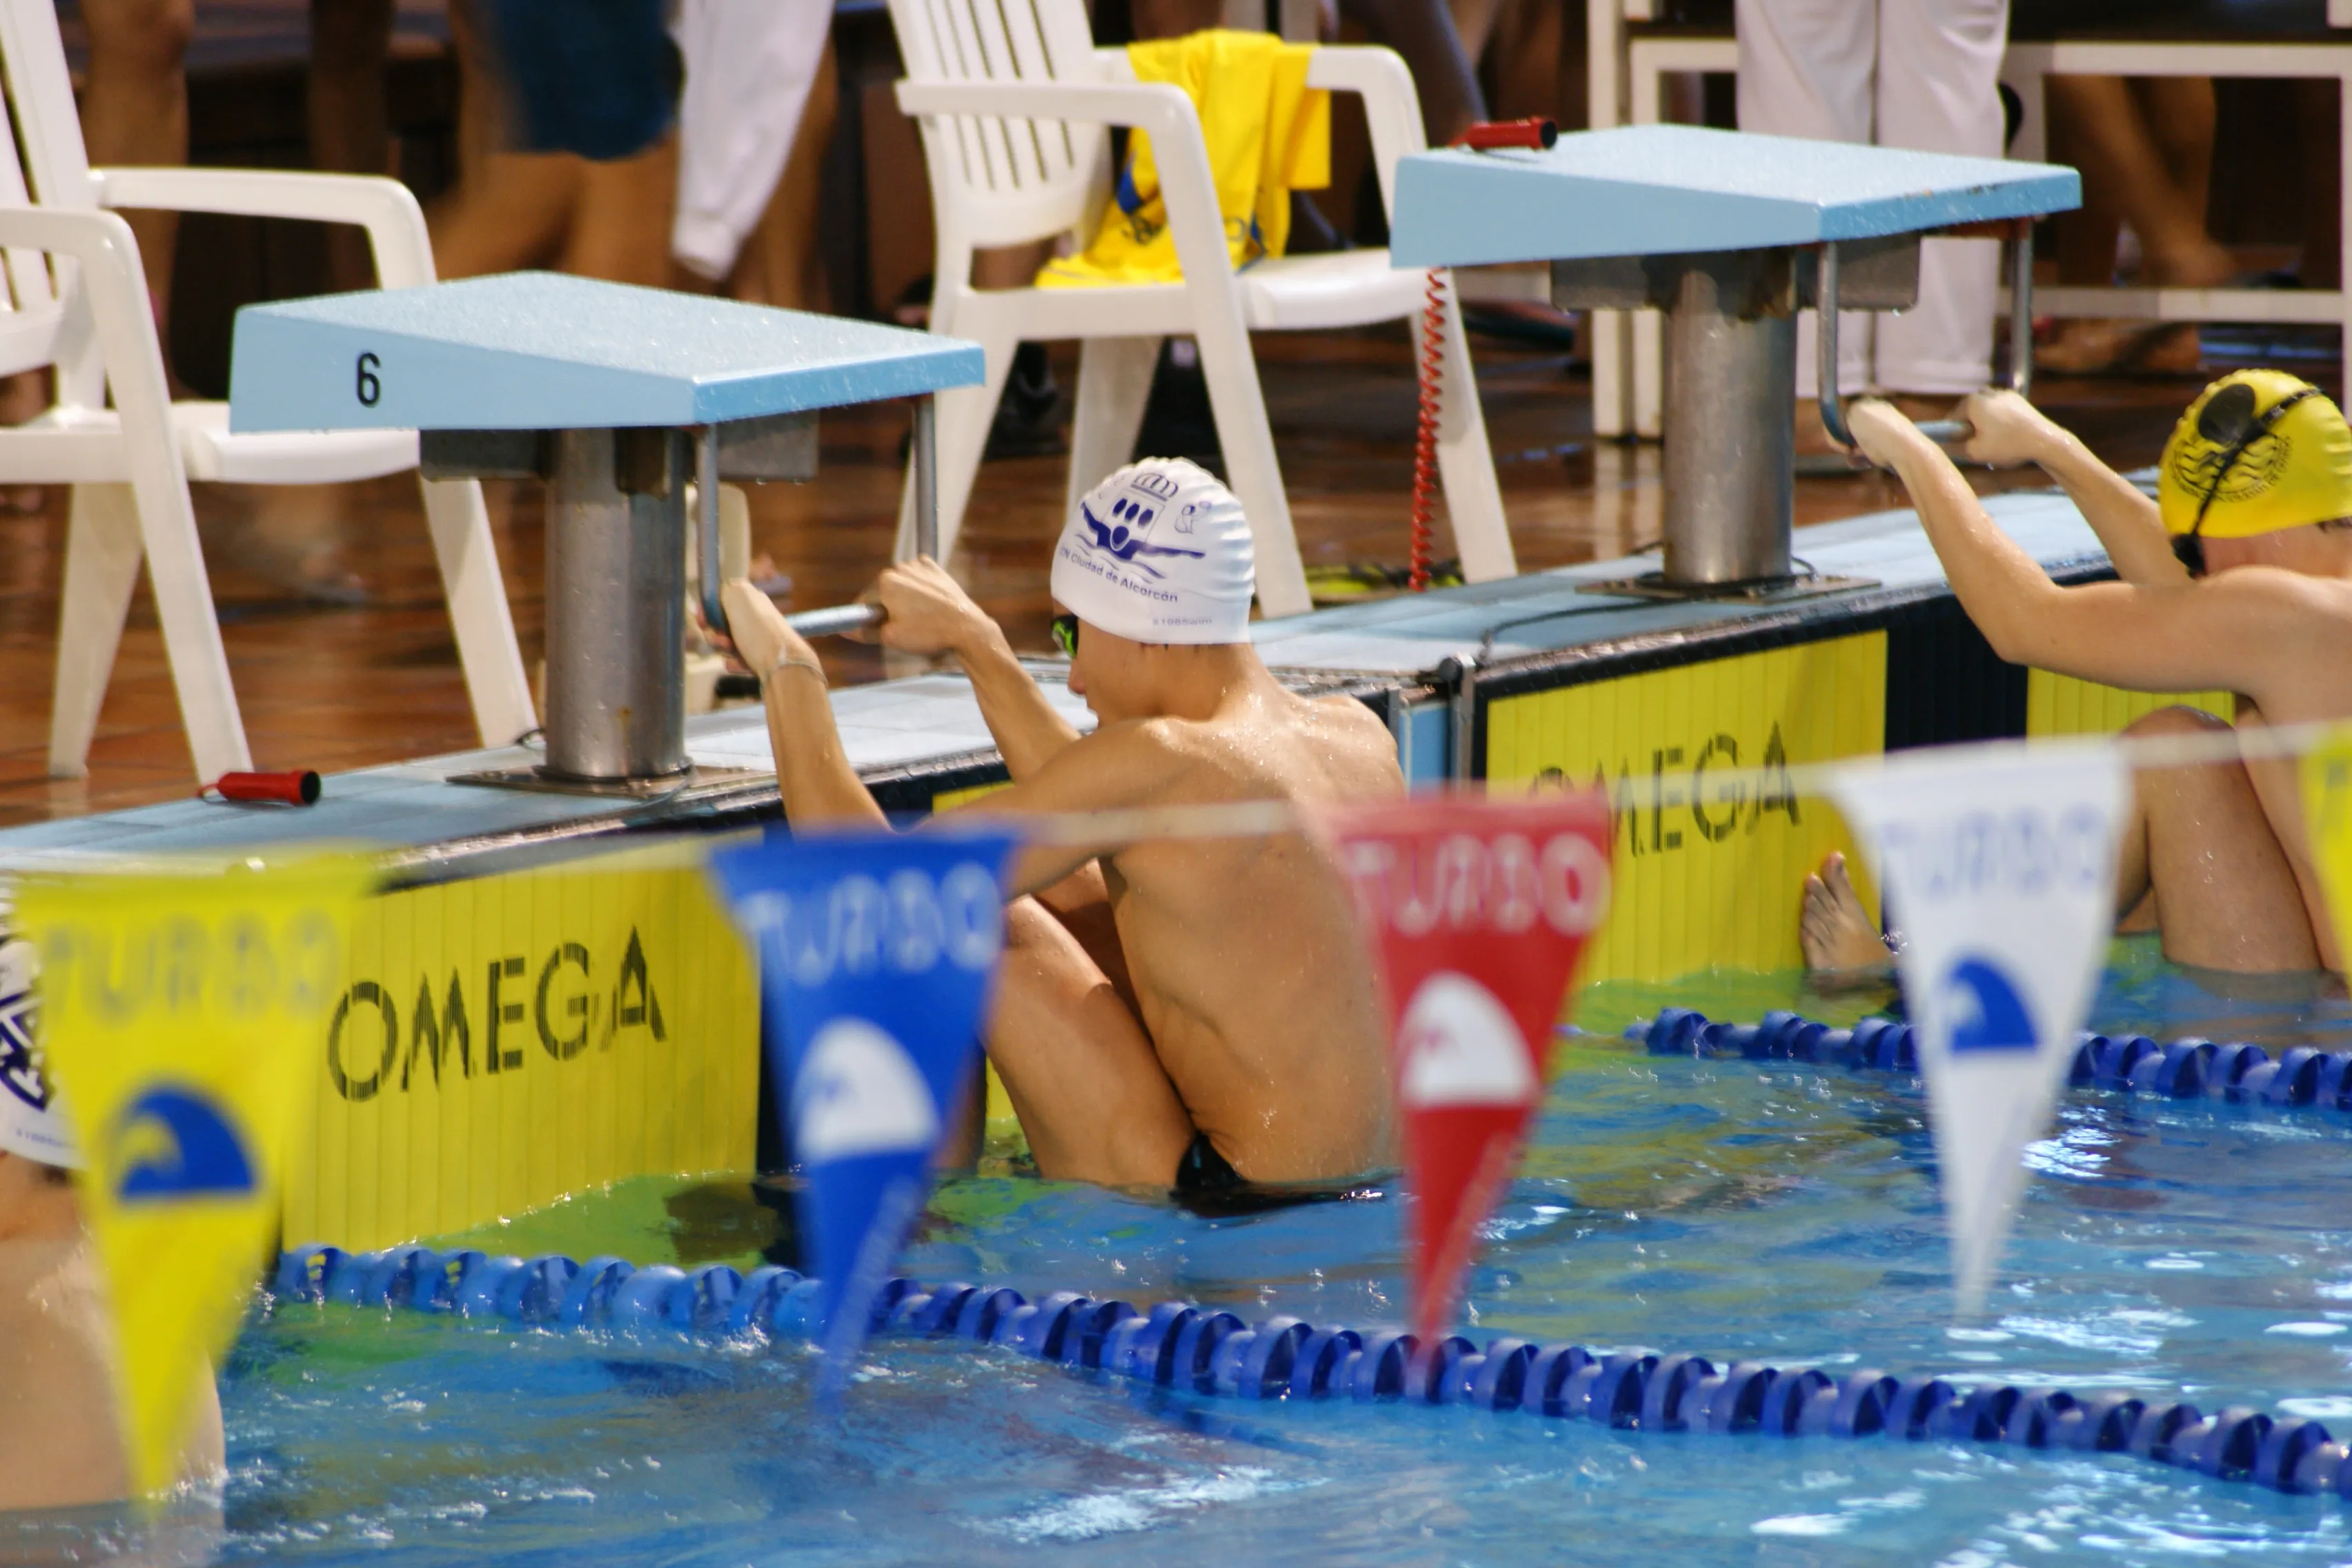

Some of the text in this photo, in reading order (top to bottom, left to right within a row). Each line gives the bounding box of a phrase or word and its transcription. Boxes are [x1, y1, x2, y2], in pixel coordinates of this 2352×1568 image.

[357, 353, 381, 409] 6
[1071, 553, 1104, 576] Ciudad
[1106, 571, 1119, 584] de
[1342, 832, 1613, 938] TURBO
[1877, 802, 2108, 904] TURBO
[41, 908, 345, 1028] TURBO
[738, 865, 1001, 986] TURBO
[327, 923, 668, 1103] OMEGA
